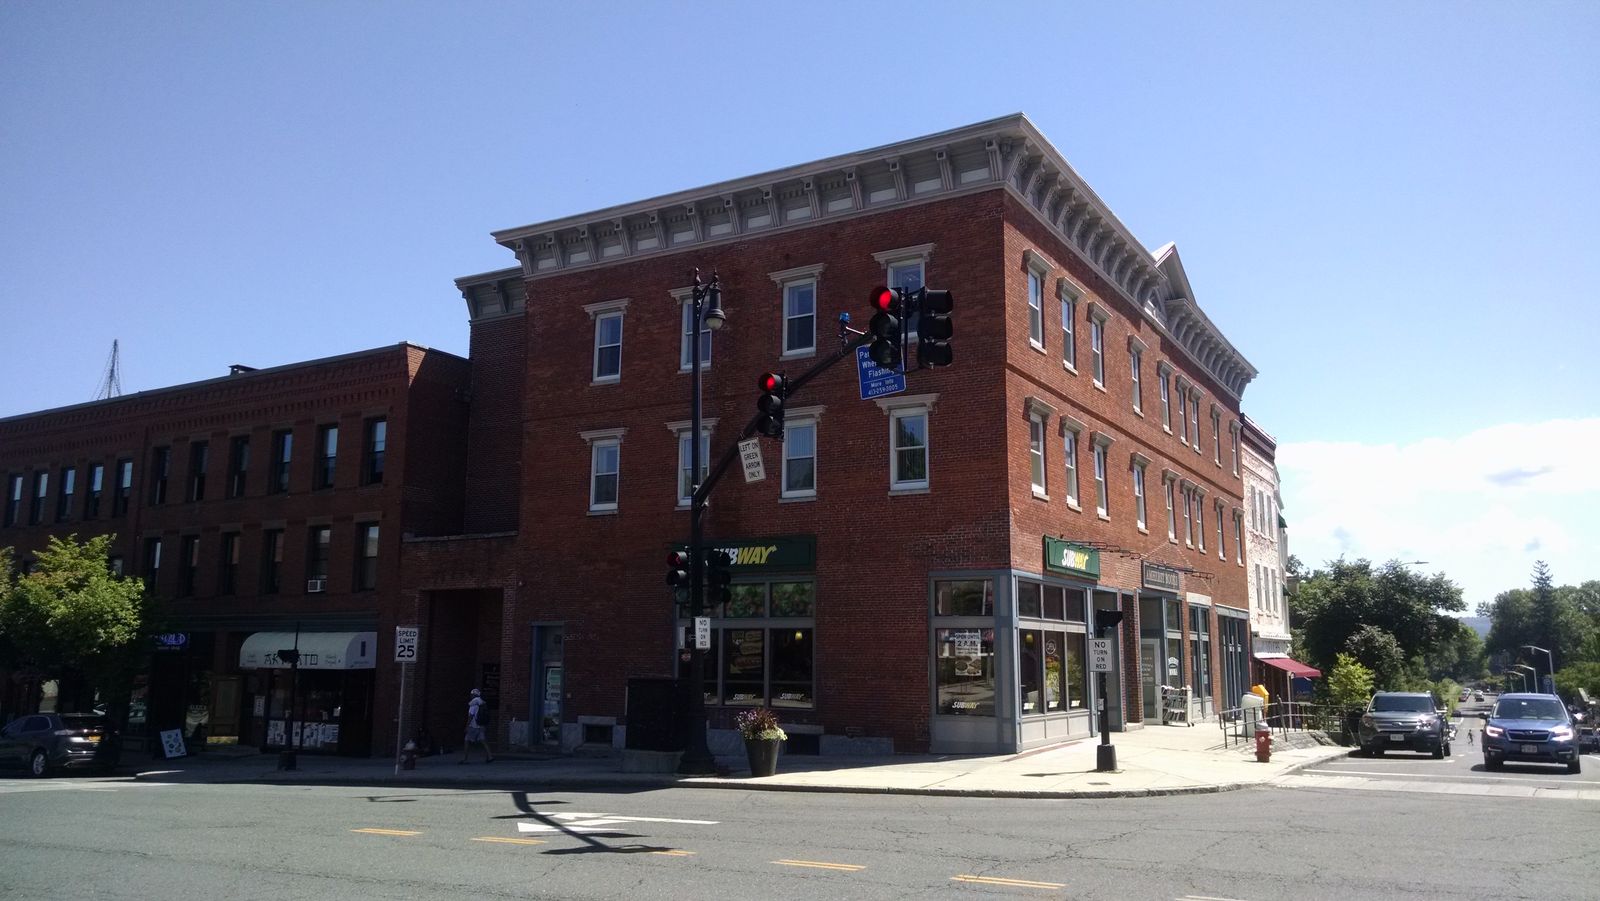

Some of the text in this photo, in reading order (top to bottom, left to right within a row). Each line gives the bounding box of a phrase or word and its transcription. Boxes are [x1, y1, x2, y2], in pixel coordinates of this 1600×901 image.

[740, 444, 751, 452] LEFT
[744, 452, 758, 460] GREEN
[746, 461, 760, 469] ARROW
[748, 471, 760, 479] ONLY
[1062, 549, 1089, 570] SUBWAY
[398, 645, 414, 658] 25
